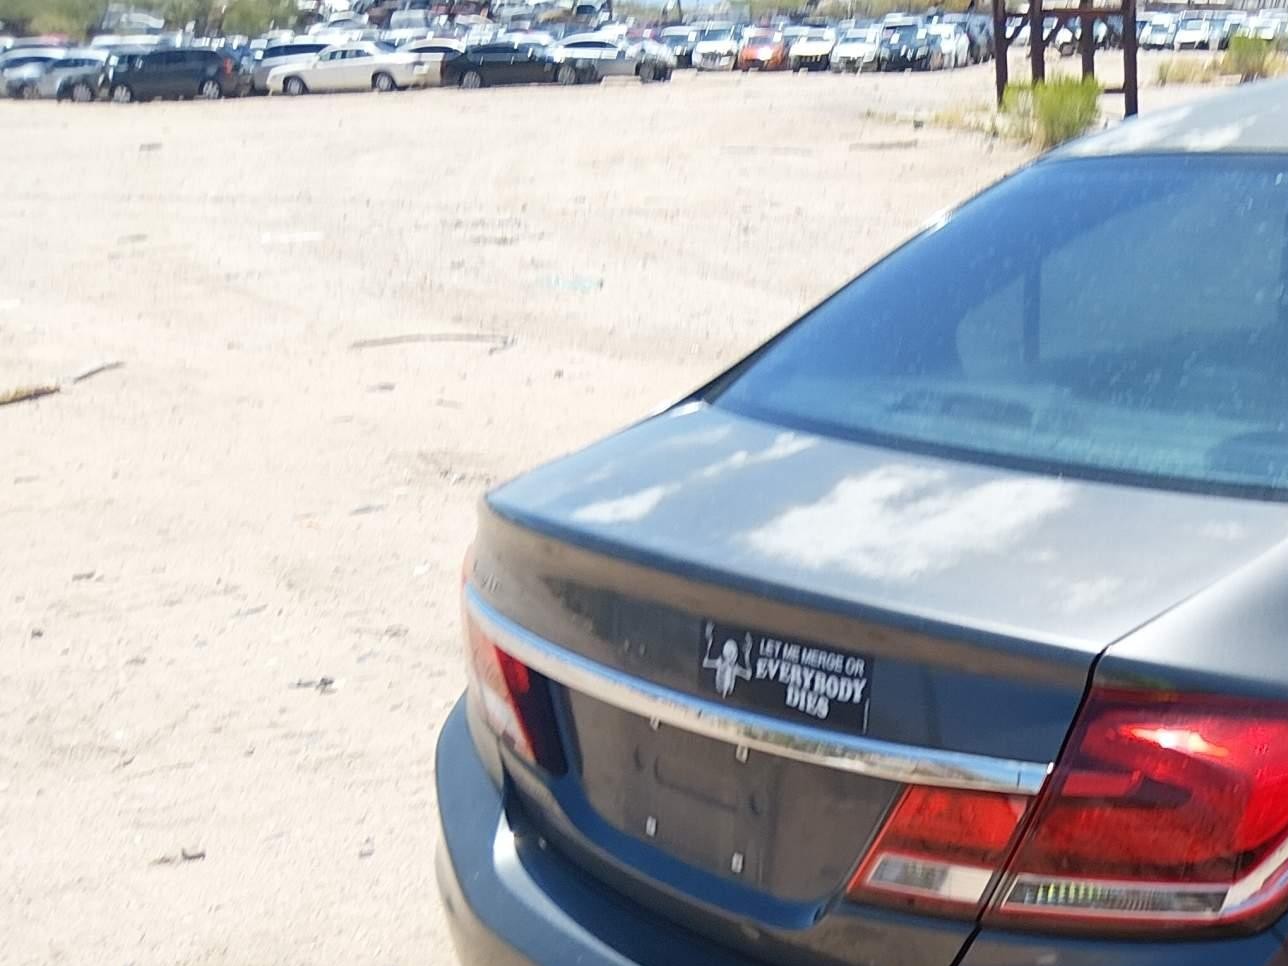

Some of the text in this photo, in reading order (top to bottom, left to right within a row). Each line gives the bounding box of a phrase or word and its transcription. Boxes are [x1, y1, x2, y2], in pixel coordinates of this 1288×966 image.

[759, 637, 866, 677] LET ME MERGE OR
[755, 657, 867, 704] EVERYBODY
